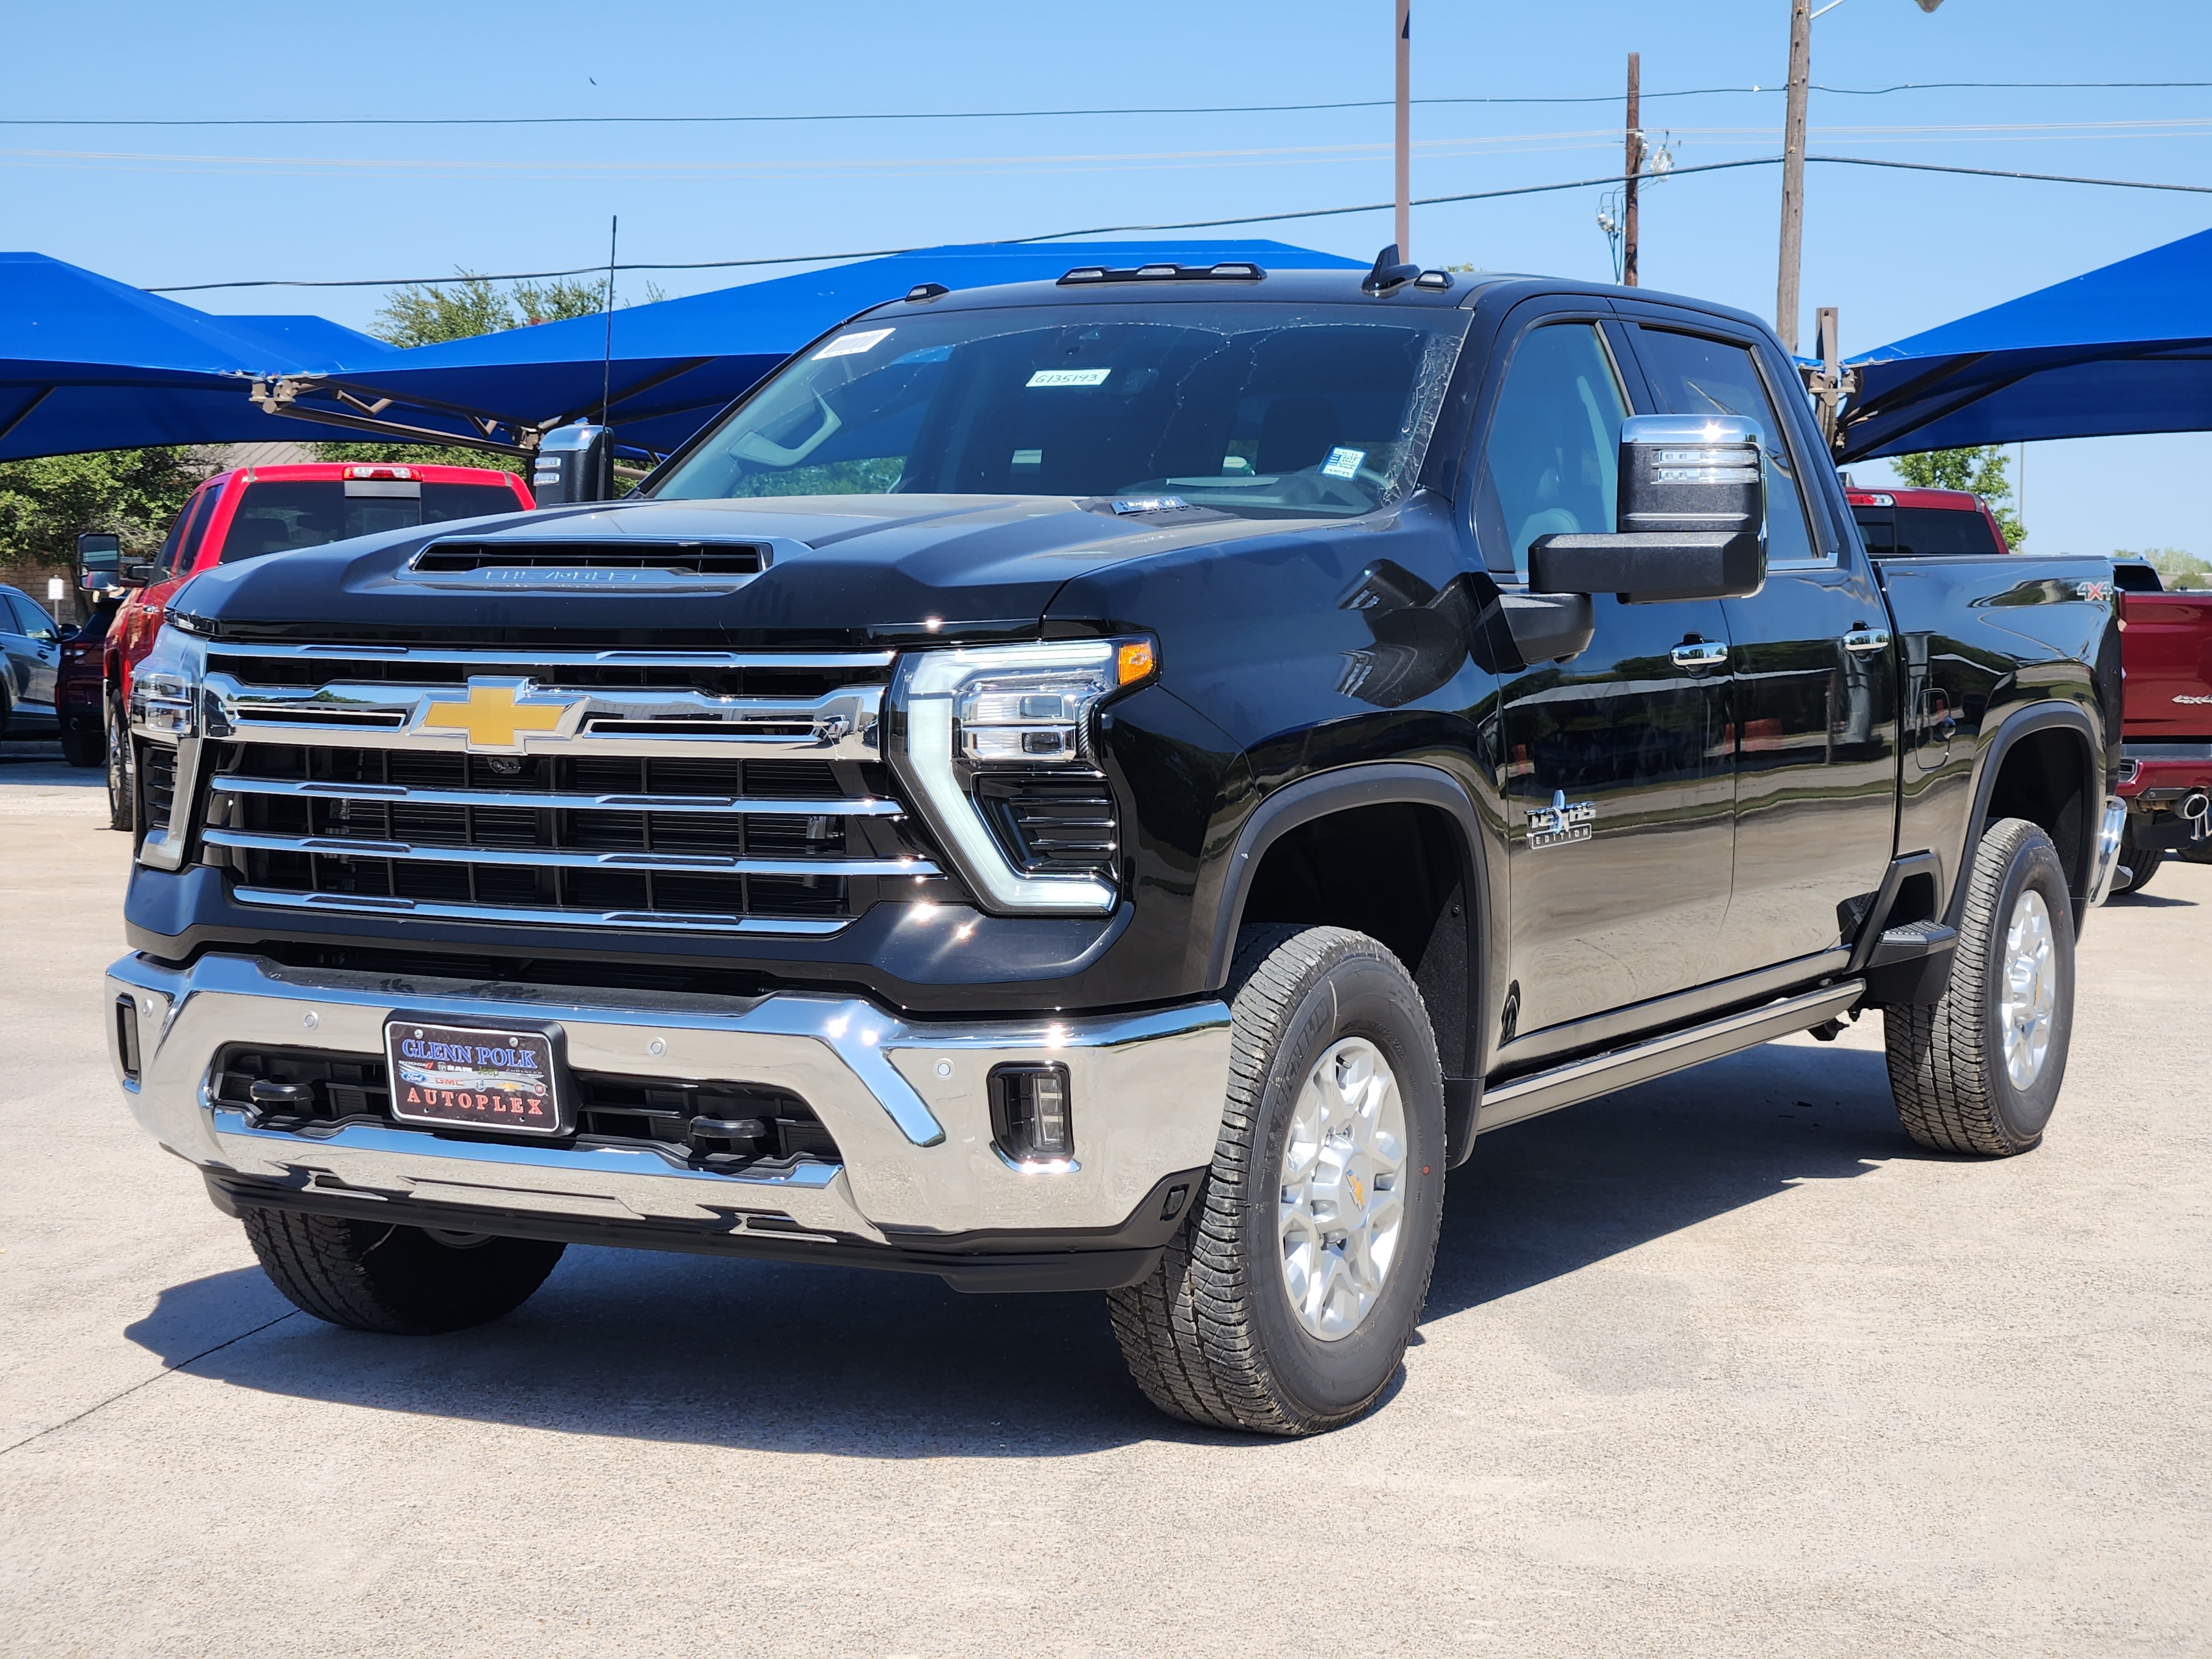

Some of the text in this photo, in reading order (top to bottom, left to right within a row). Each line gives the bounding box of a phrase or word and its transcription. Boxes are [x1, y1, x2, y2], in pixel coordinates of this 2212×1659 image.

[1536, 828, 1589, 844] EDITION
[402, 1038, 538, 1069] GLENN POLK
[406, 1073, 465, 1086] Ford GMC
[477, 1066, 499, 1077] Jeep
[407, 1087, 543, 1115] AUTOPLEX
